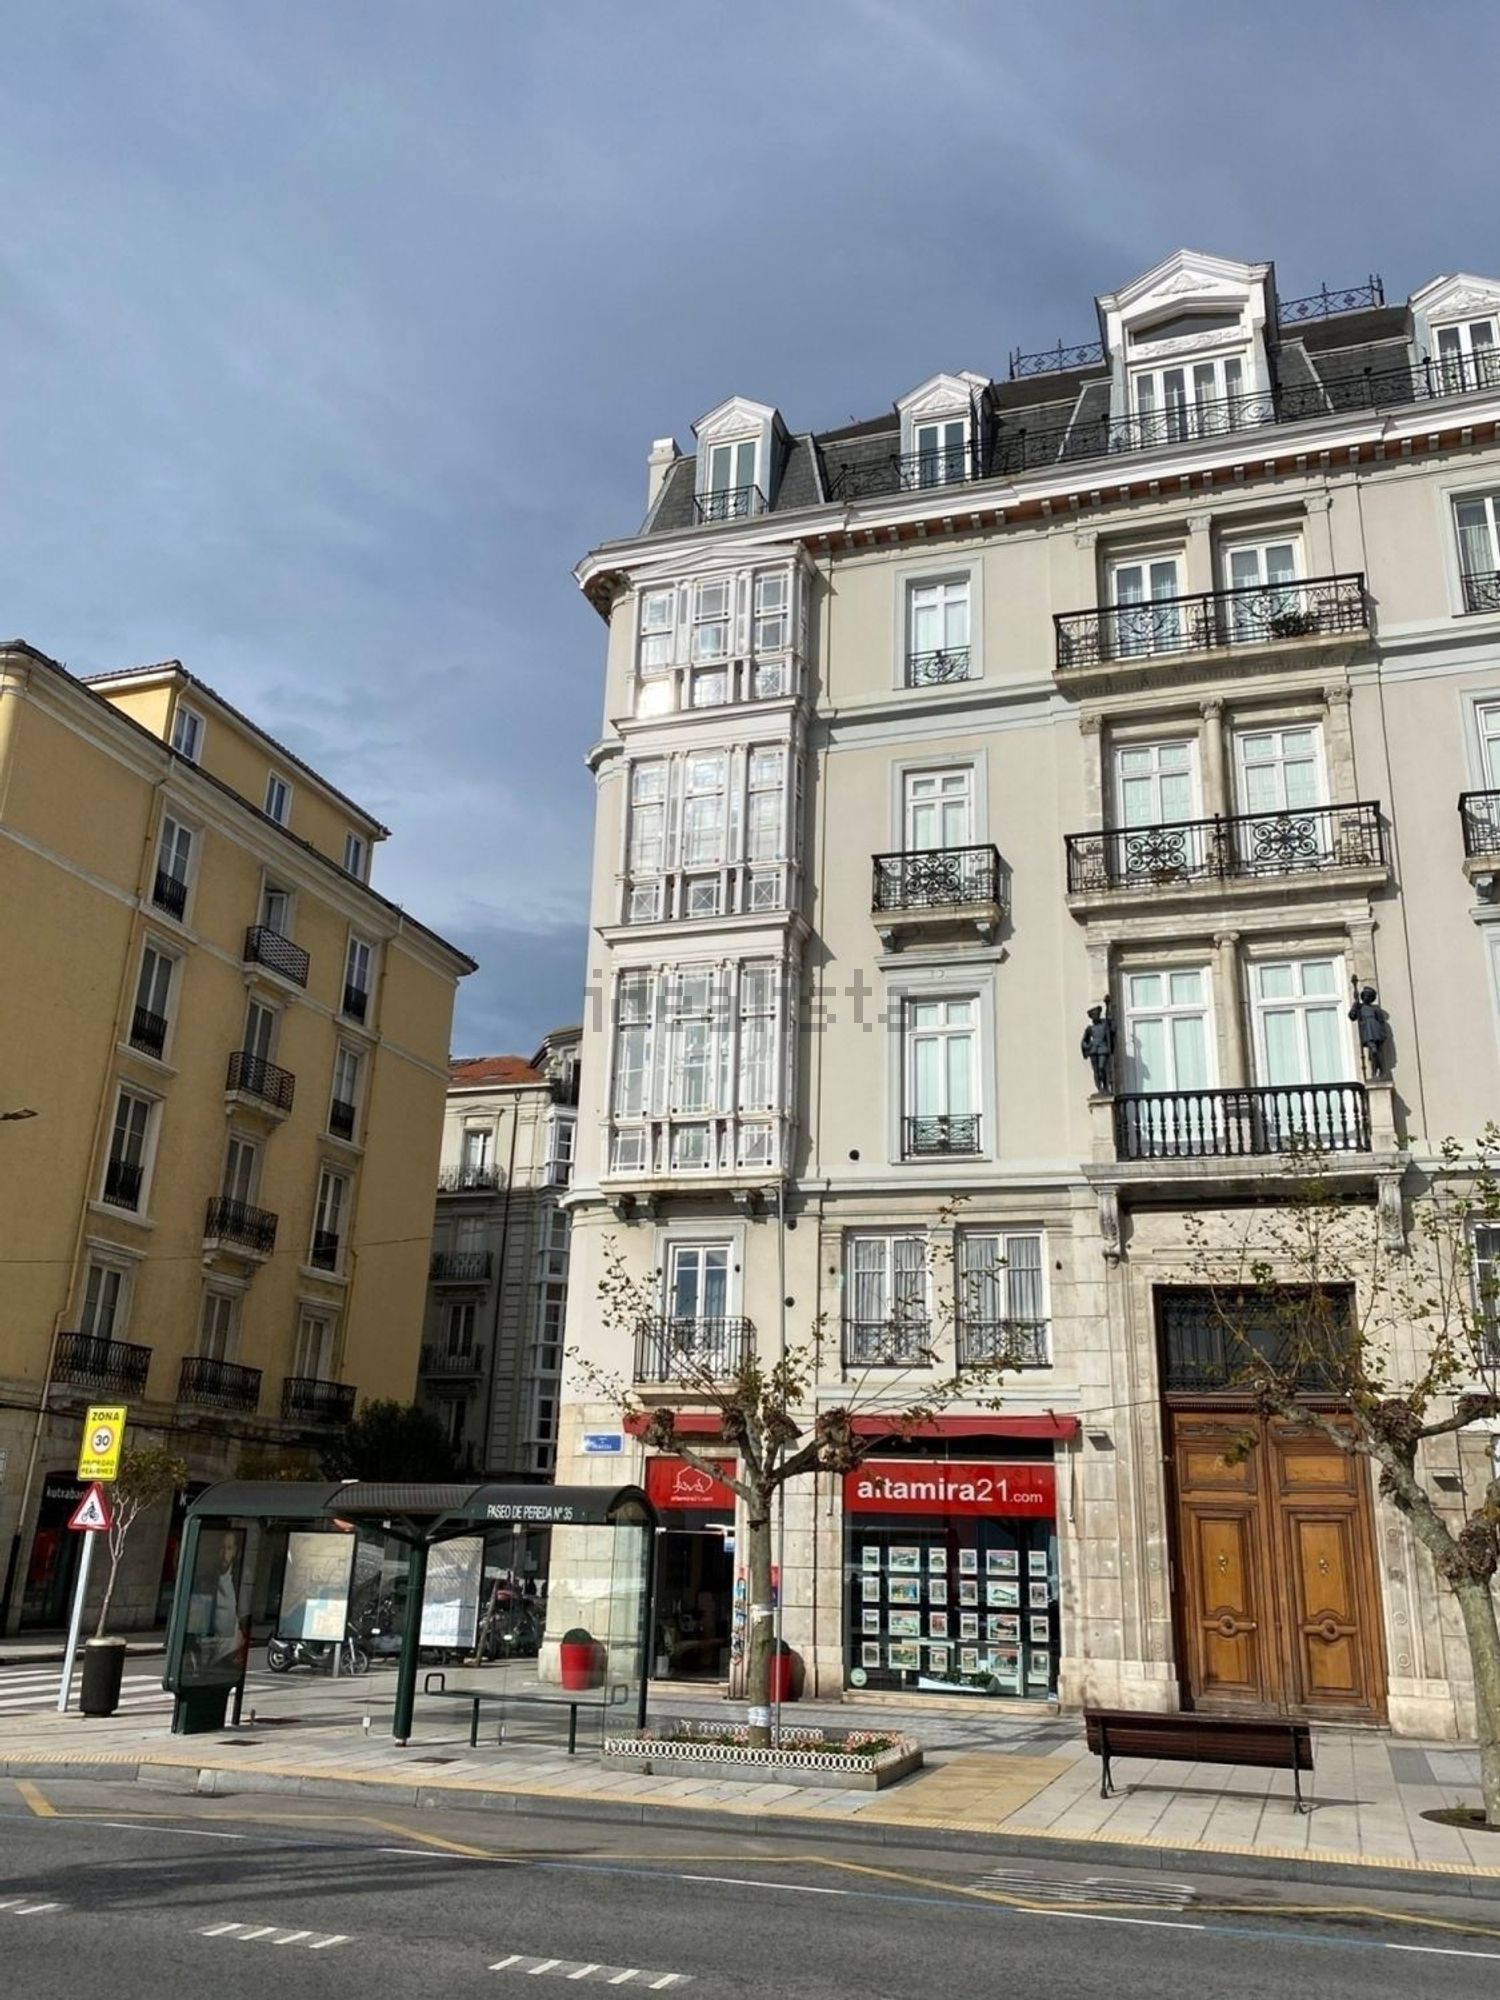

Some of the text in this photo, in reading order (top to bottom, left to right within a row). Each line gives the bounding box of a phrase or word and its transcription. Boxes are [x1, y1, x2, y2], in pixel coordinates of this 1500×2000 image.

[92, 1411, 120, 1422] ZONA
[95, 1434, 110, 1447] 30
[46, 1484, 86, 1500] kutxaban
[486, 1504, 511, 1519] PASEO
[512, 1505, 523, 1519] DE
[523, 1505, 552, 1520] PEREDA
[563, 1507, 573, 1521] 35
